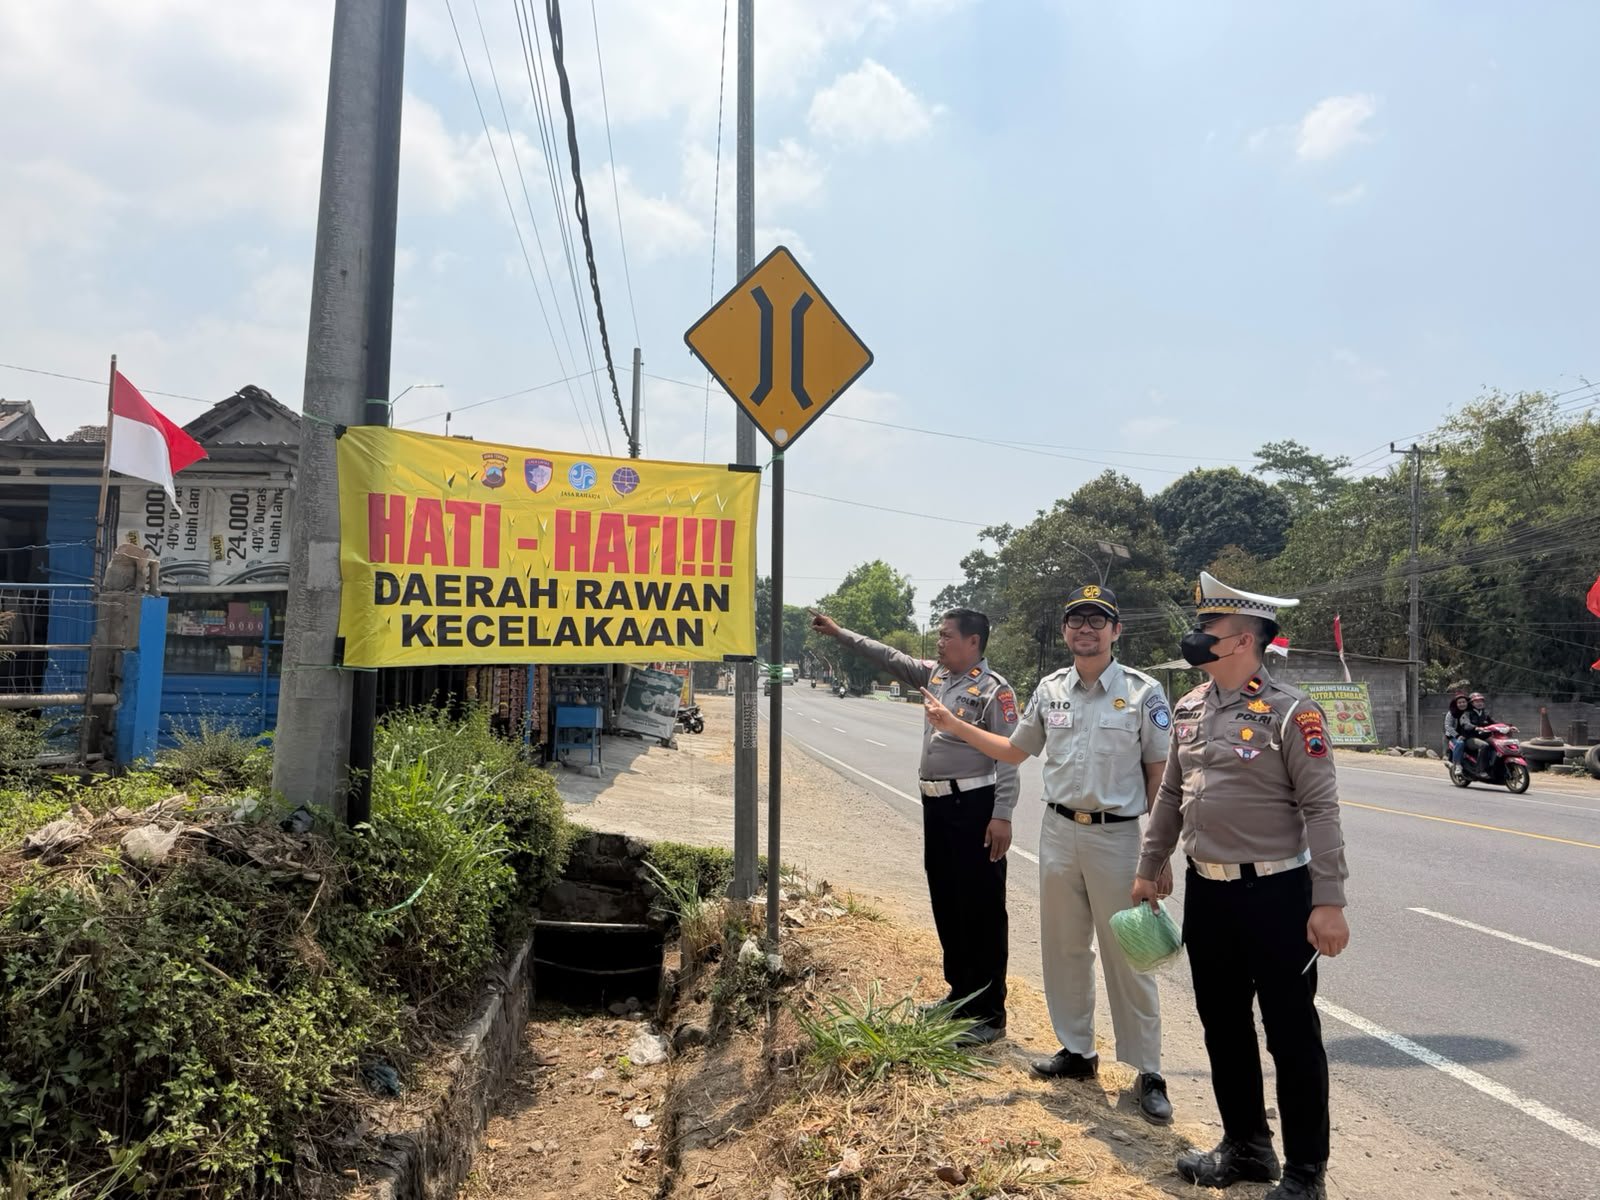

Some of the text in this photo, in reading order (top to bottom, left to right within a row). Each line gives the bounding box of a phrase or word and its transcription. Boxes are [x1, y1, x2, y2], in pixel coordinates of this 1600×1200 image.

[575, 491, 600, 500] RAHARJA
[166, 523, 180, 550] 40%
[183, 518, 199, 551] Lebih
[251, 526, 265, 553] 40%
[268, 521, 282, 553] Lebih
[368, 492, 736, 577] HATI - HATI!!!
[374, 571, 730, 612] DAERAH RAWAN
[401, 614, 704, 647] KECELAKAAN
[1050, 701, 1071, 710] RIO
[1235, 712, 1272, 725] POLRI
